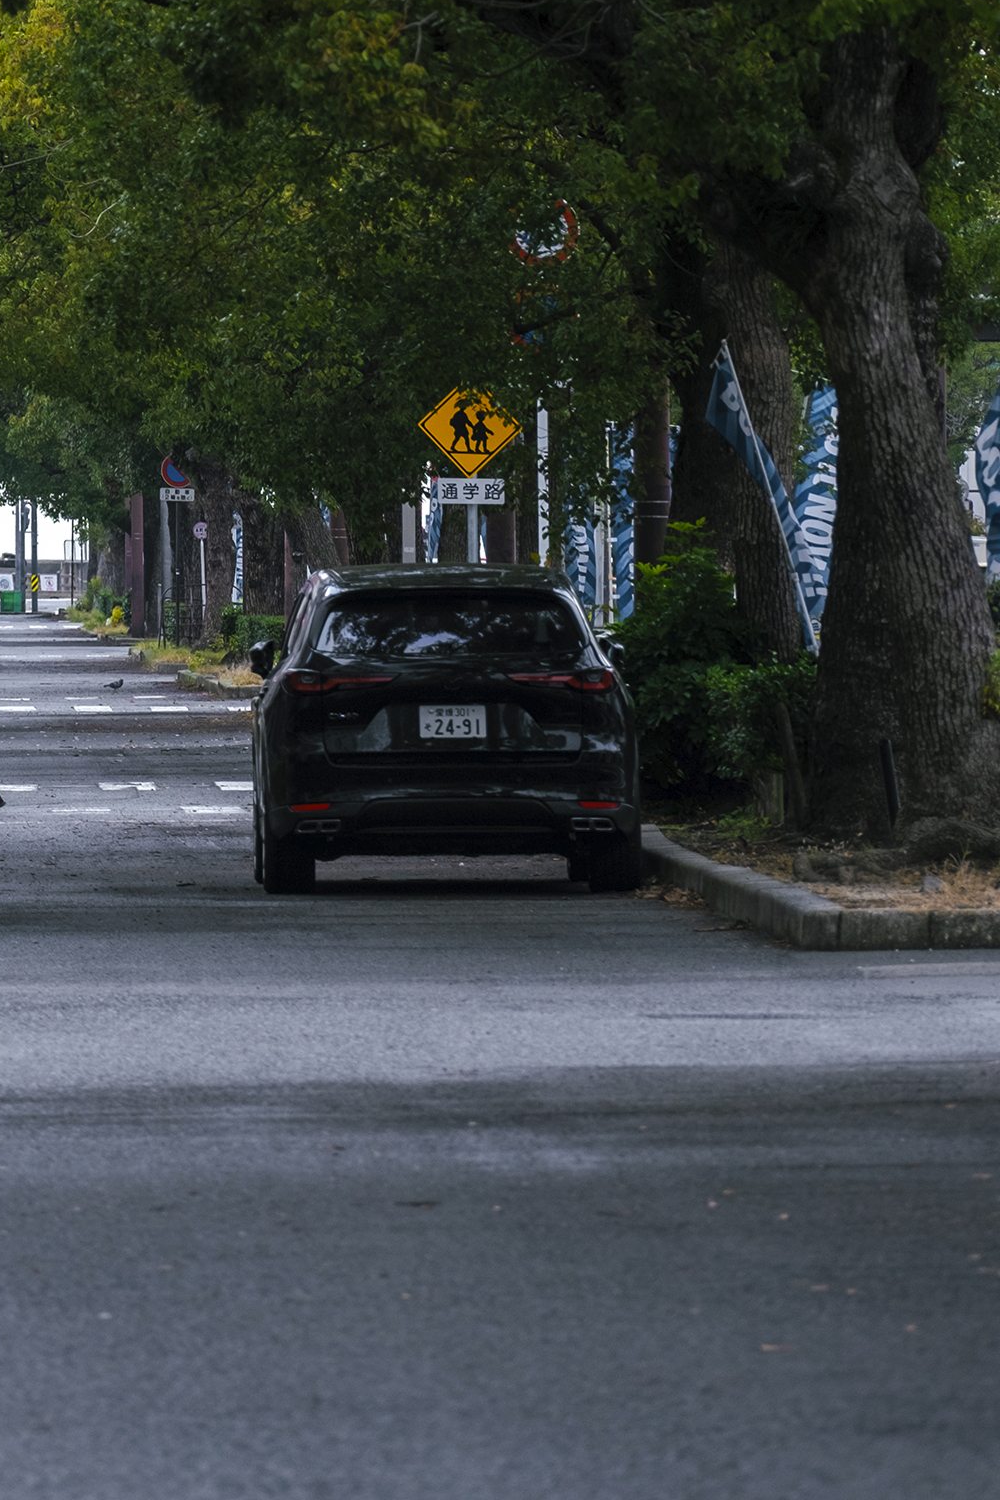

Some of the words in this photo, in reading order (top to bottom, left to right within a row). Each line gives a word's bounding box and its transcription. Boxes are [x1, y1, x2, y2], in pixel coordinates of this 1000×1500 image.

[441, 482, 501, 500] 通学路
[434, 718, 480, 735] 24-91
